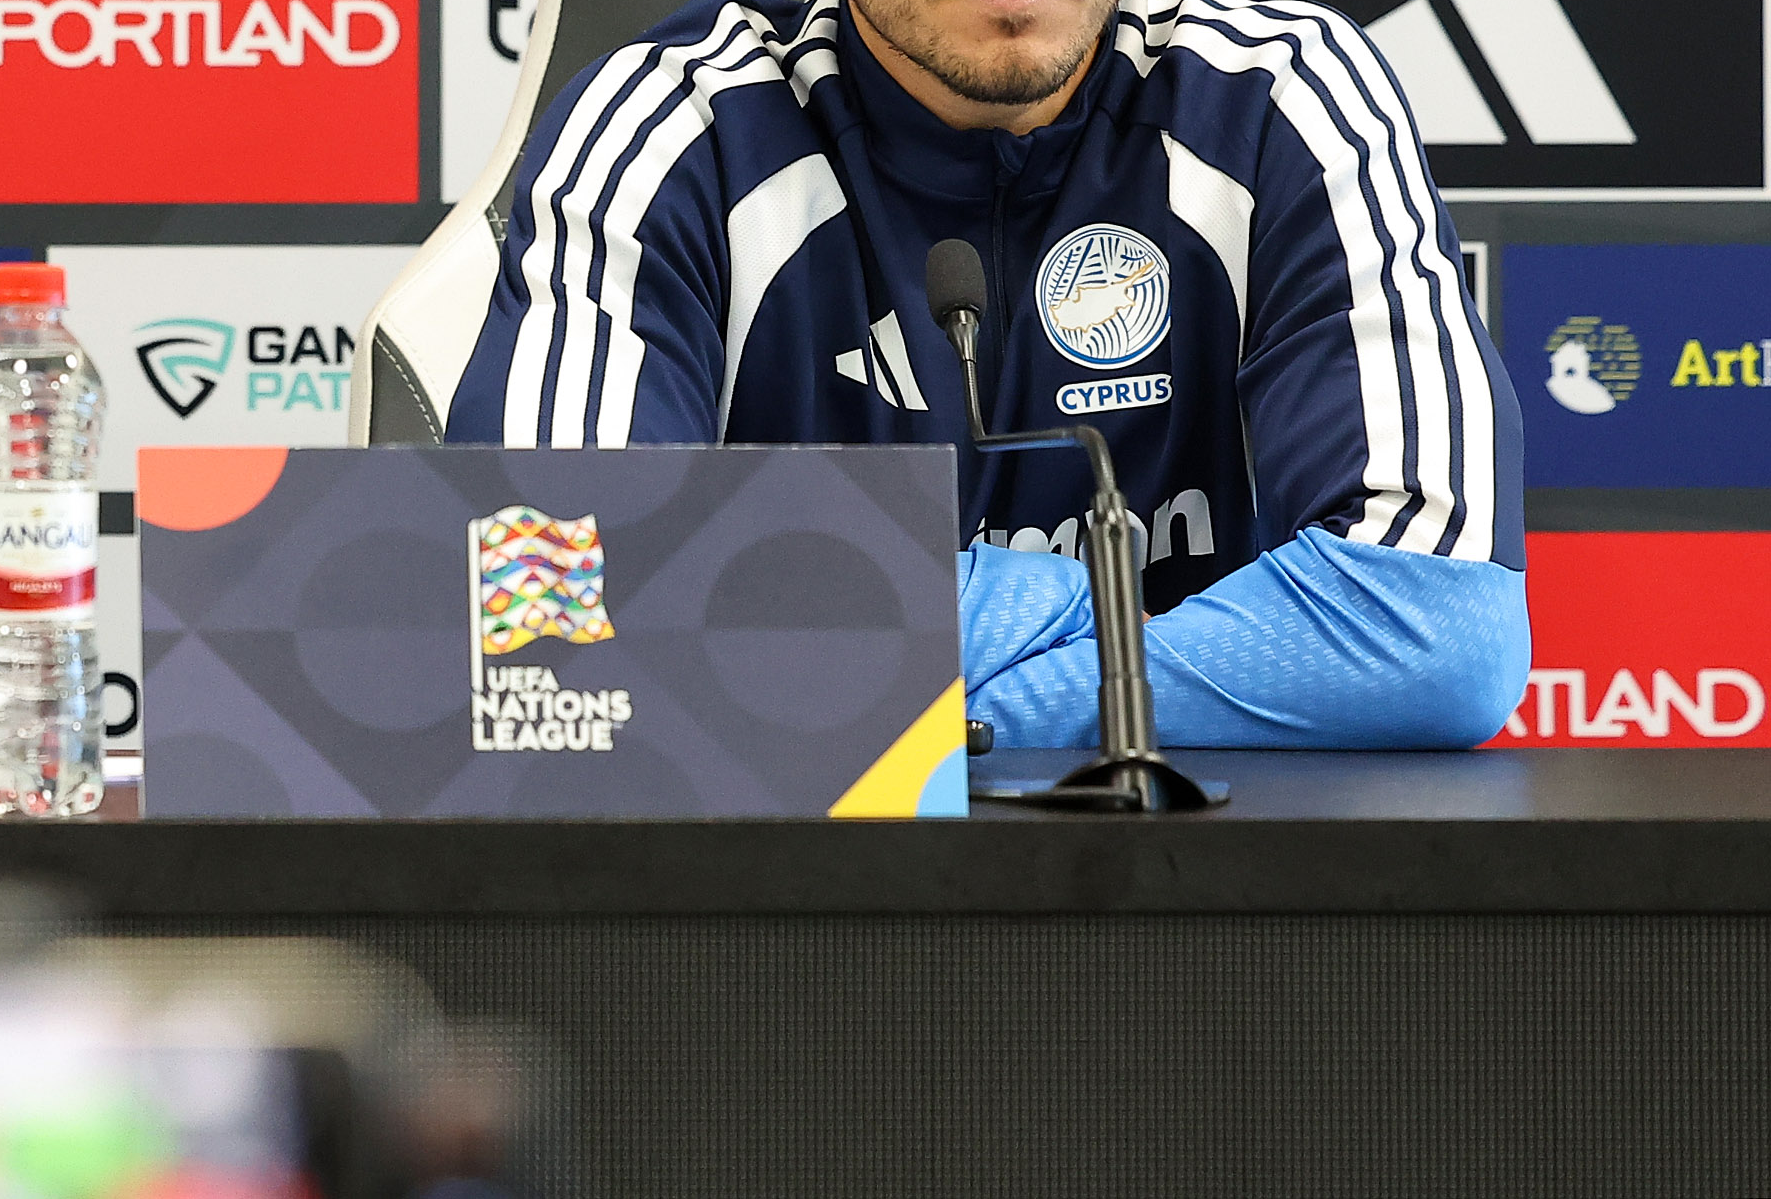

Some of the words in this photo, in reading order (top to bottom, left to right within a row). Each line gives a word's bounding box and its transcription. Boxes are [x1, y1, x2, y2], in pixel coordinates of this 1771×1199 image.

[1061, 378, 1169, 410] CYPRUS
[486, 665, 561, 693] UEFA
[472, 688, 633, 722] NATIONS
[473, 718, 614, 751] LEAGUE
